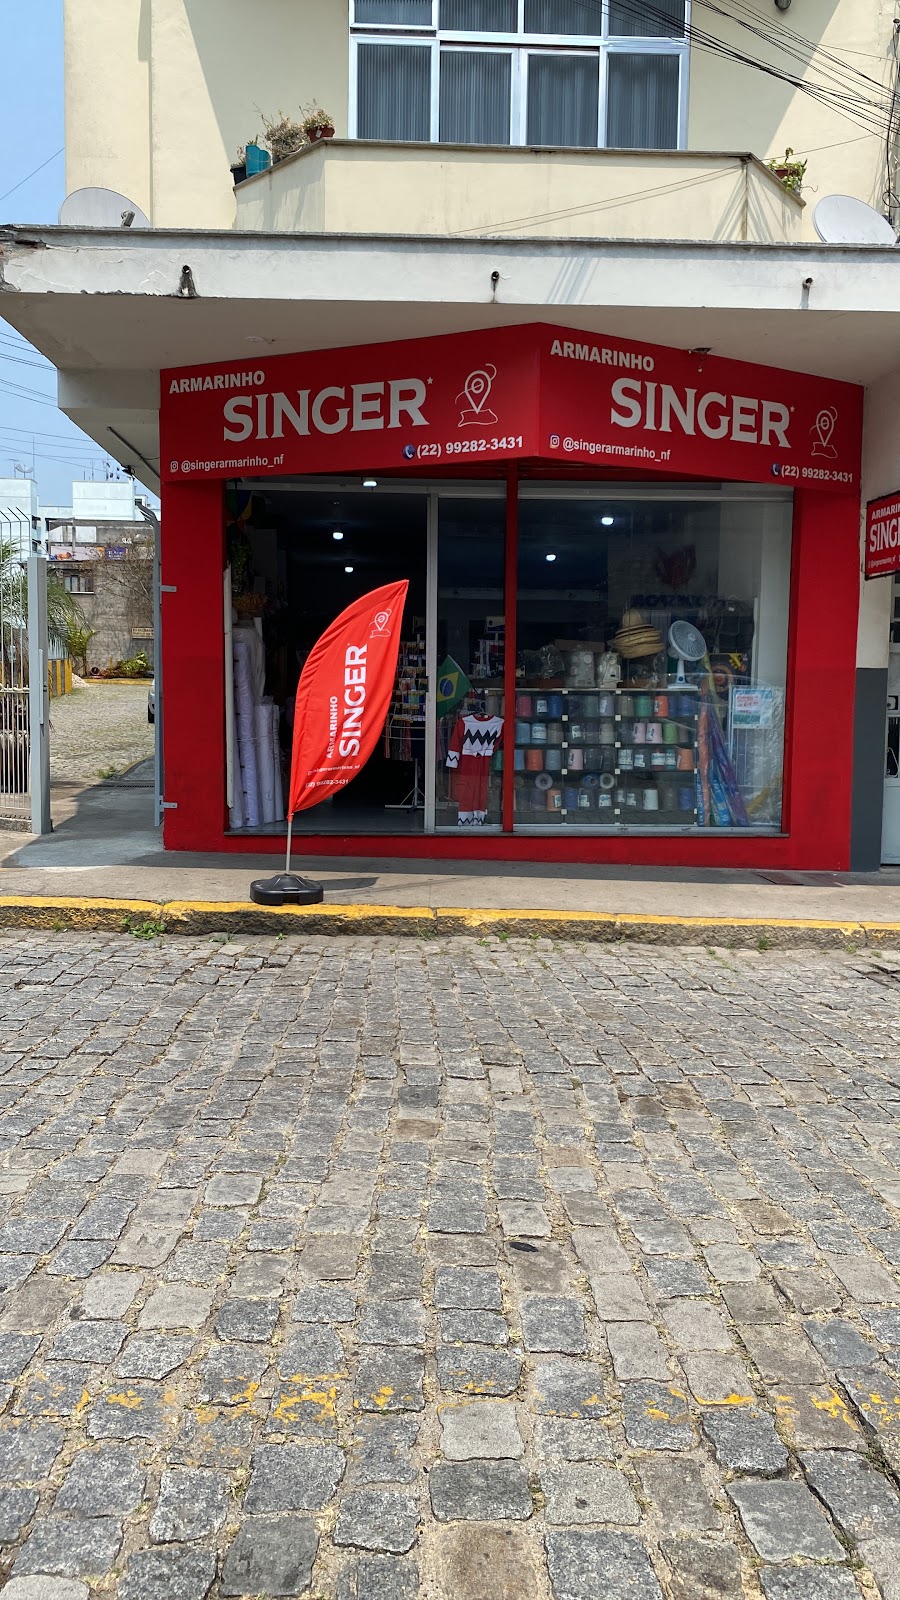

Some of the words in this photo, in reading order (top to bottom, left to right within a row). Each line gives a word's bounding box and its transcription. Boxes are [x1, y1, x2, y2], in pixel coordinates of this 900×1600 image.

[550, 339, 655, 372] ARMARINHO
[169, 370, 266, 394] ARMARINHO
[223, 377, 430, 442] SINGER
[610, 377, 792, 449] SINGER
[416, 443, 442, 459] (22)
[445, 435, 524, 455] 99282-3431
[562, 436, 672, 463] @singerarmarinho_nf
[181, 453, 285, 473] @singerarmarinho_nf
[781, 464, 800, 480] (22)
[801, 467, 853, 483] 99282-3431
[339, 643, 368, 757] SINGER
[326, 695, 338, 759] ARMARINHO
